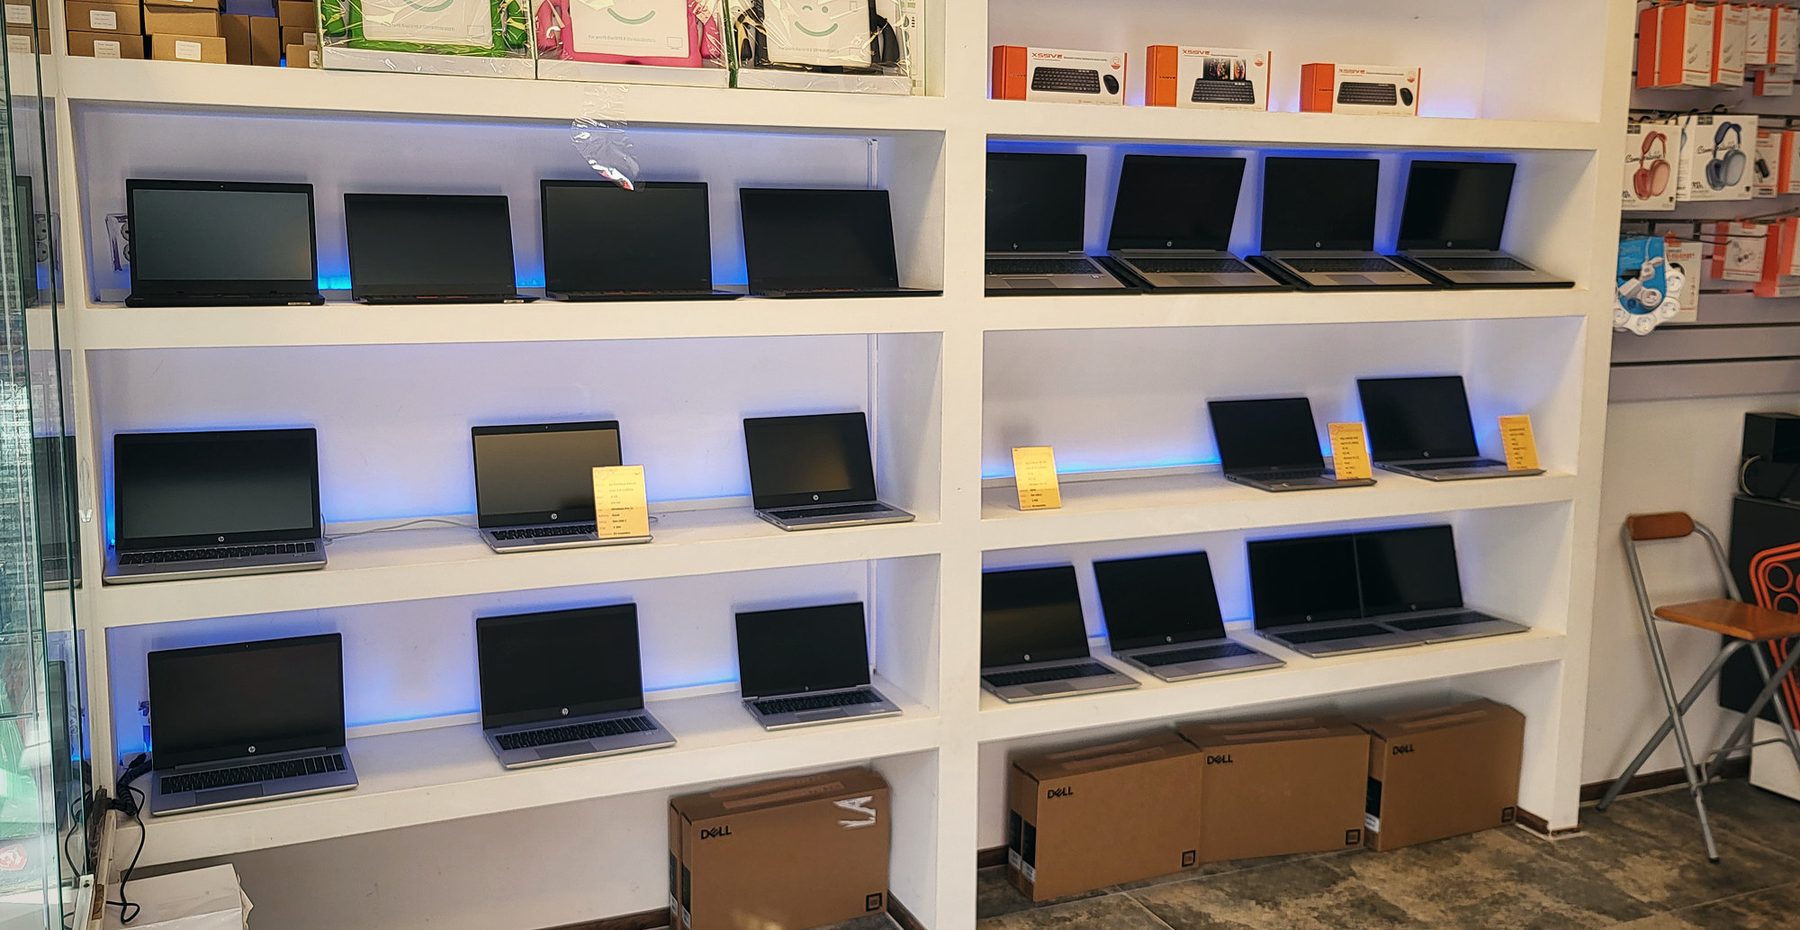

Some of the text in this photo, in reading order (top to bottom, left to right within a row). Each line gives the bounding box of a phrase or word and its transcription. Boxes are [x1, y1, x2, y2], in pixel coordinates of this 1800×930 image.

[1392, 744, 1415, 756] DELL
[1206, 754, 1233, 765] DELL
[1047, 786, 1074, 799] DELL
[701, 825, 732, 840] DELL
